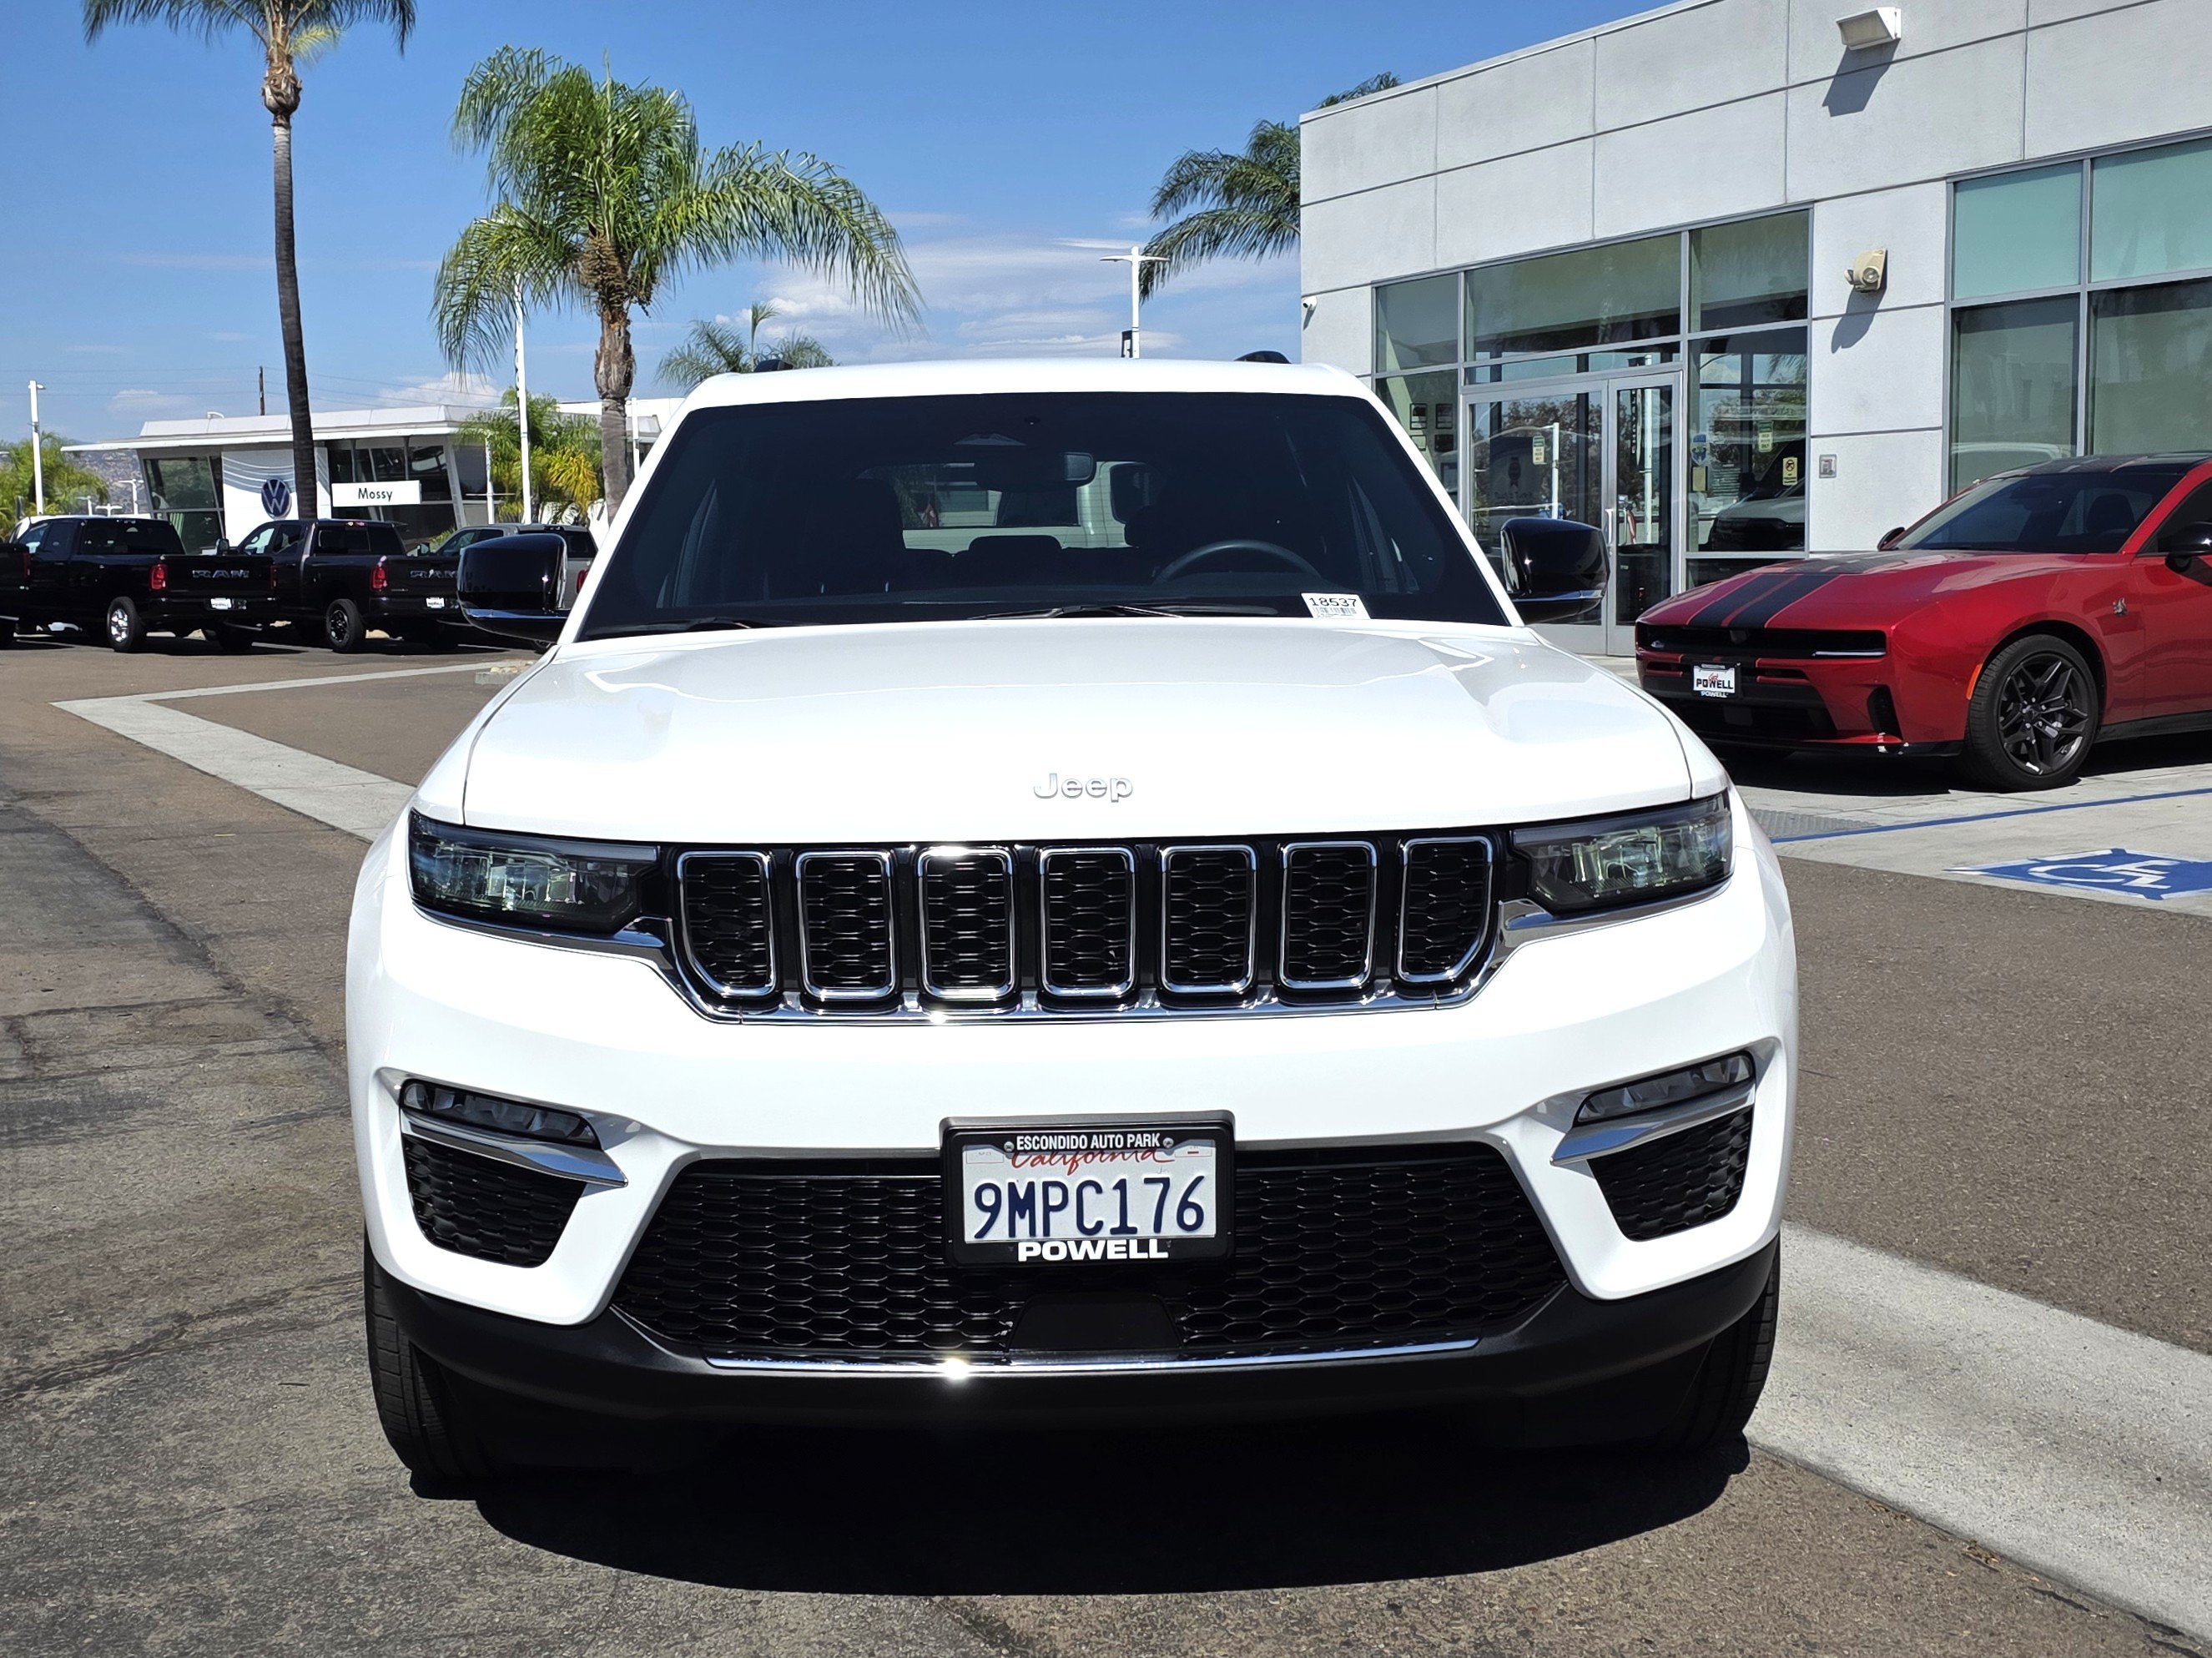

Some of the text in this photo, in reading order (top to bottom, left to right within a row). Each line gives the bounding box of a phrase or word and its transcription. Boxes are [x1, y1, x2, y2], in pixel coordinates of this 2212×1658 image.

[358, 487, 393, 502] Mossy
[192, 569, 249, 578] RAM
[1310, 597, 1357, 607] 18537
[1696, 678, 1733, 689] POWELL
[1033, 773, 1133, 803] Jeep
[1016, 1133, 1161, 1151] ESCONDIDO AUTO PARK
[1010, 1148, 1175, 1176] California
[974, 1176, 1205, 1239] 9MPC176
[1018, 1239, 1169, 1262] POWELL
